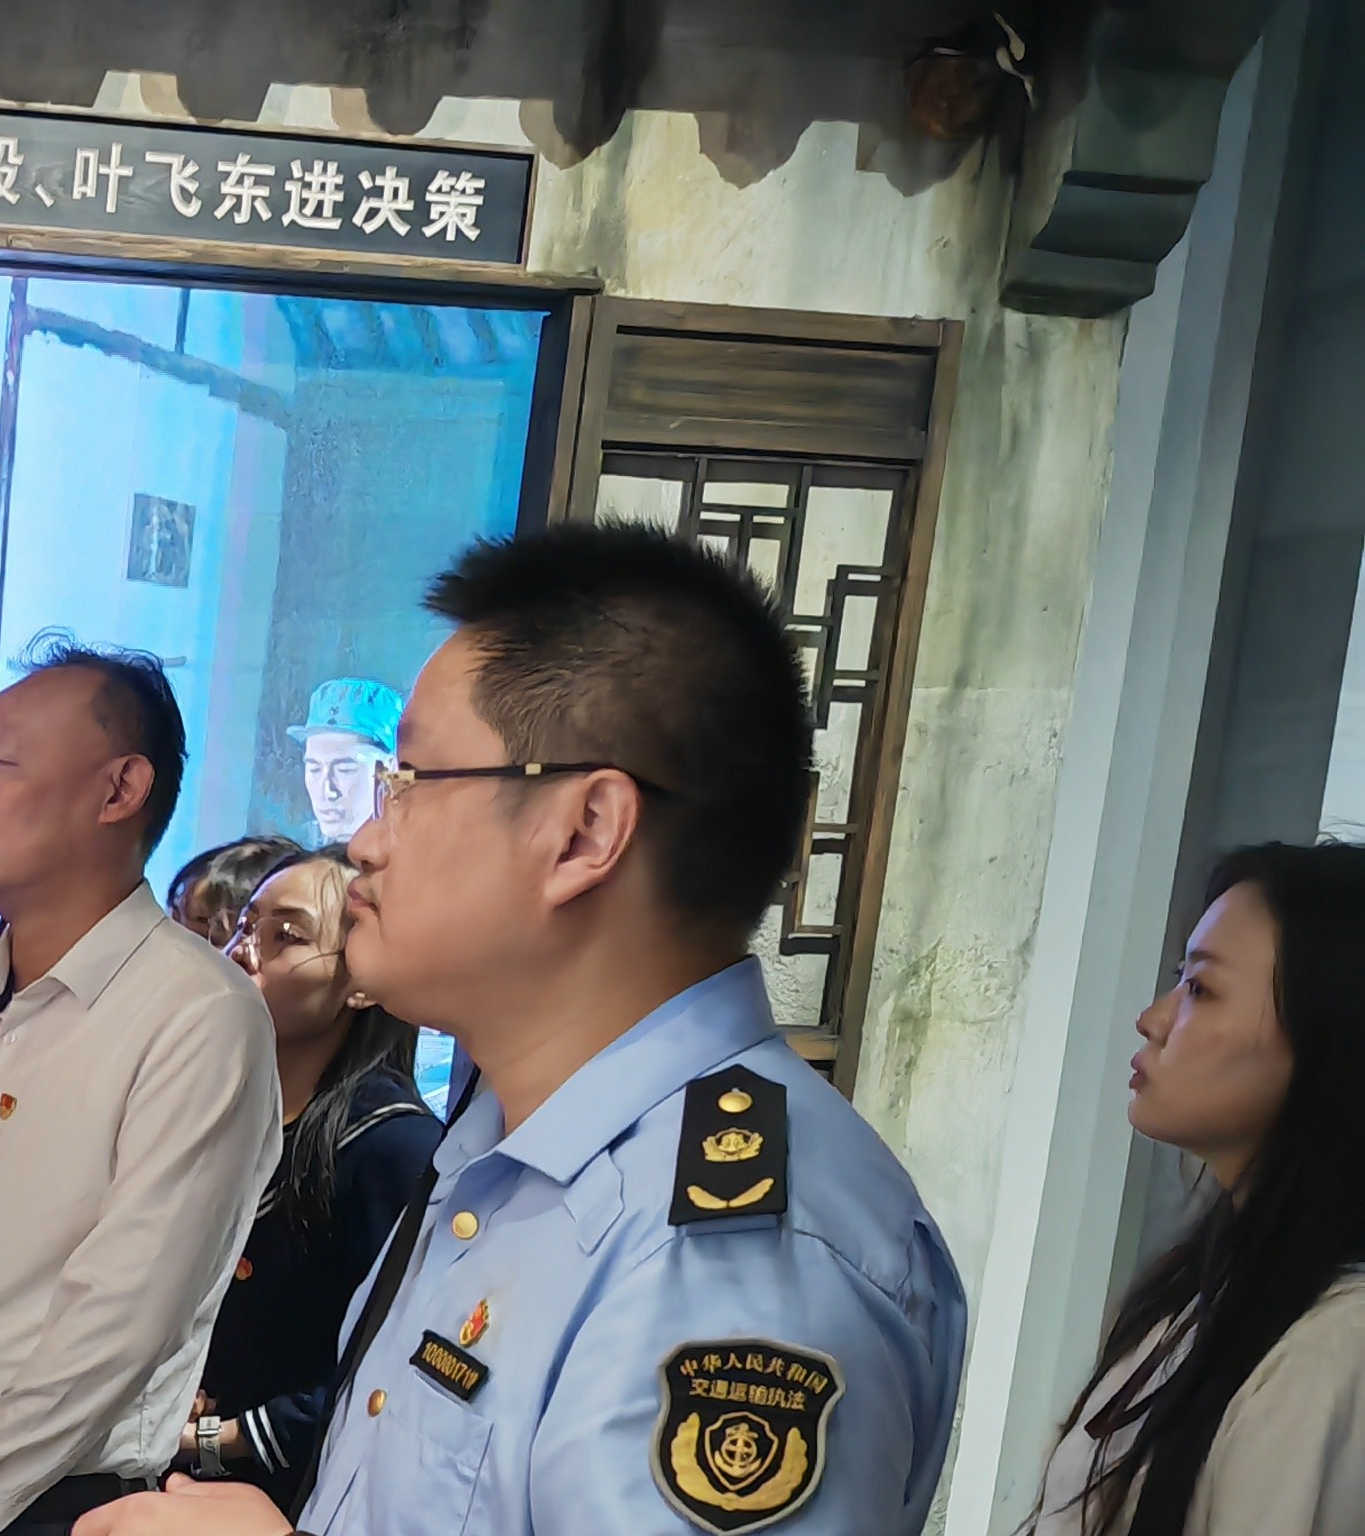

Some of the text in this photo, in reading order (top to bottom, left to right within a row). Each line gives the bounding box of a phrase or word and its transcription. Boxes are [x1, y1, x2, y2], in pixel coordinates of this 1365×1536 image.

[679, 1352, 829, 1395] 中华人民共和国
[688, 1377, 807, 1412] 交通运输执法
